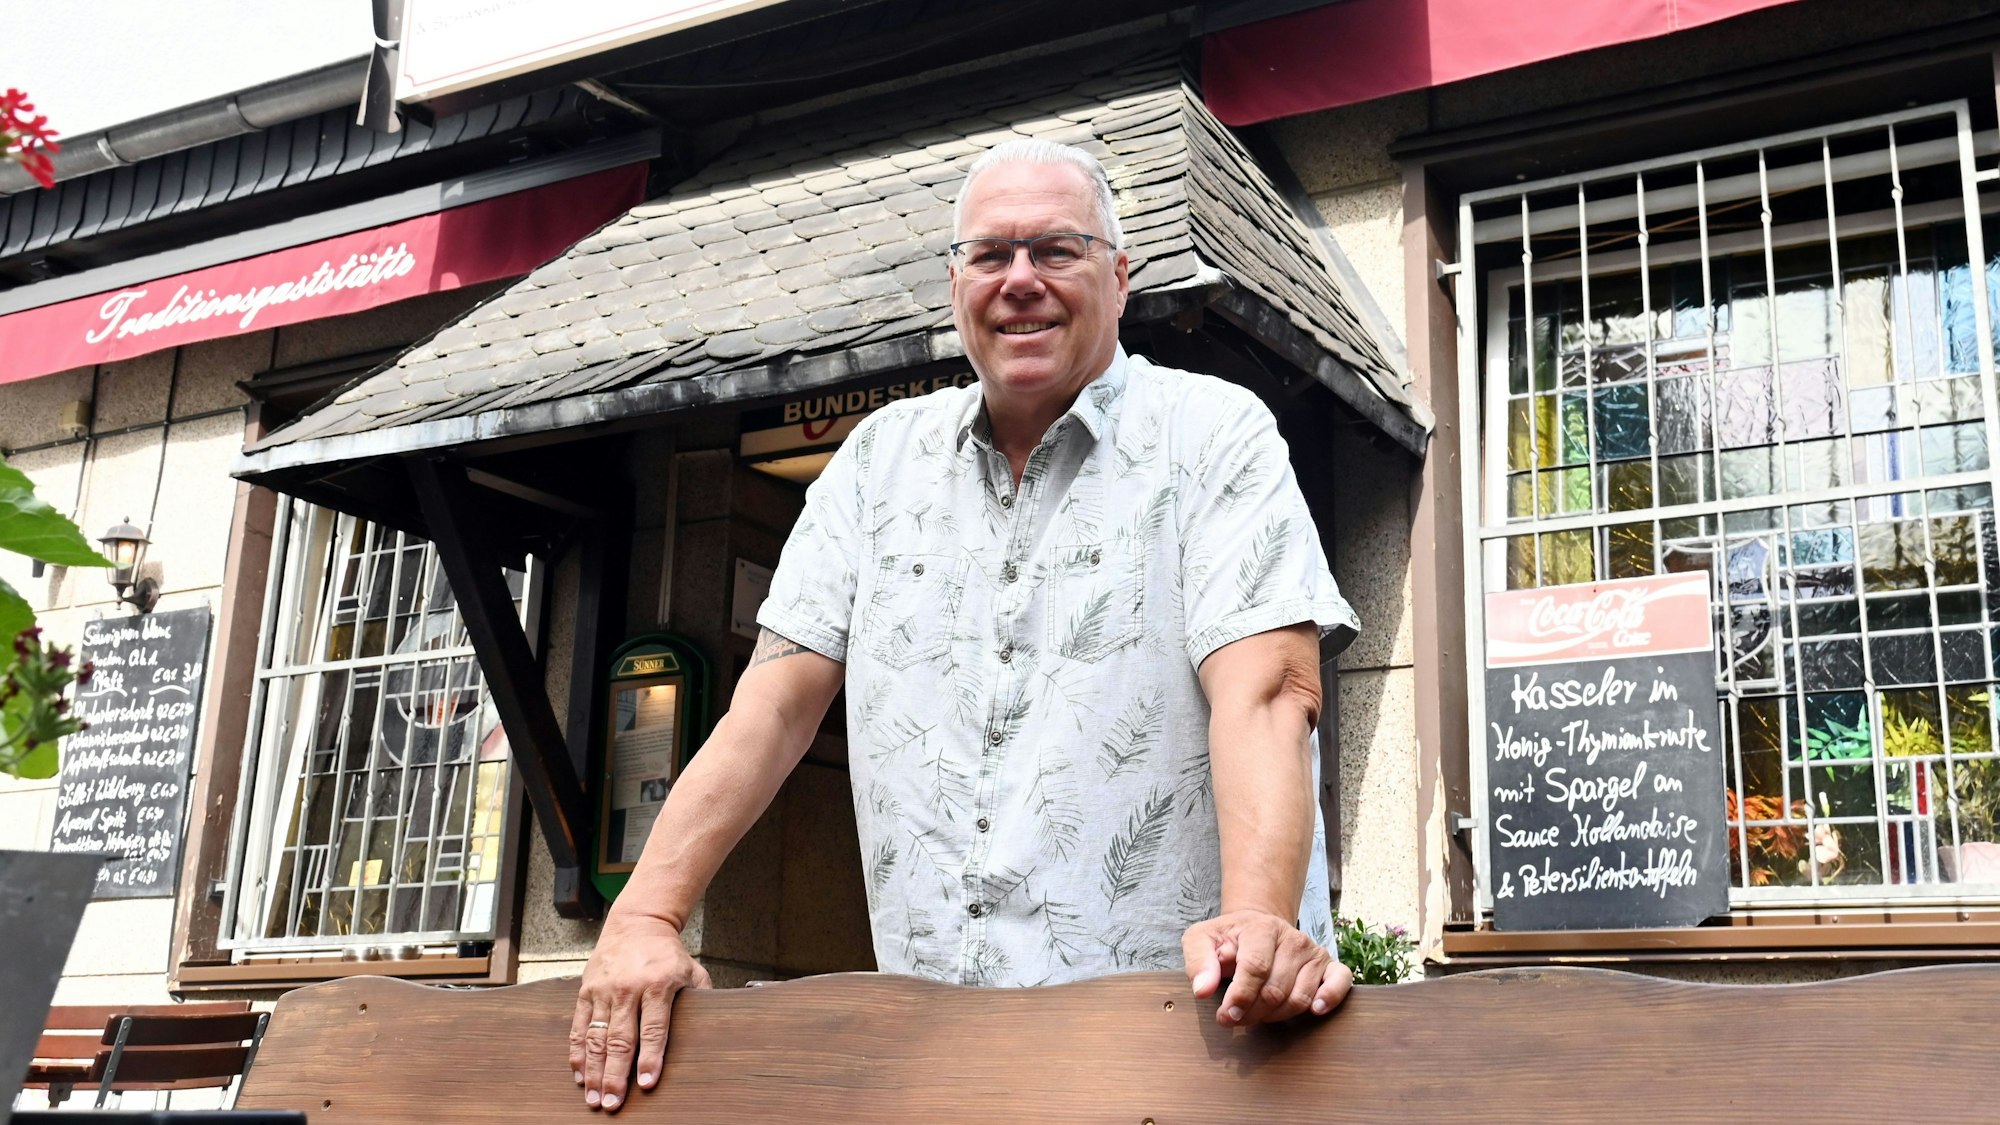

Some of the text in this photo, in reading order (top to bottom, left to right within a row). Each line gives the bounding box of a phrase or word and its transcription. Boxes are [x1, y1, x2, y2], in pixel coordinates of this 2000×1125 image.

[86, 242, 416, 344] Traditionsgaststätte
[1510, 665, 1679, 714] Kasseler in
[1494, 760, 1683, 812] mit Spargel an
[1495, 807, 1698, 848] Sauce Hollandaise
[1497, 847, 1698, 898] & Petersilienkartoffeln
